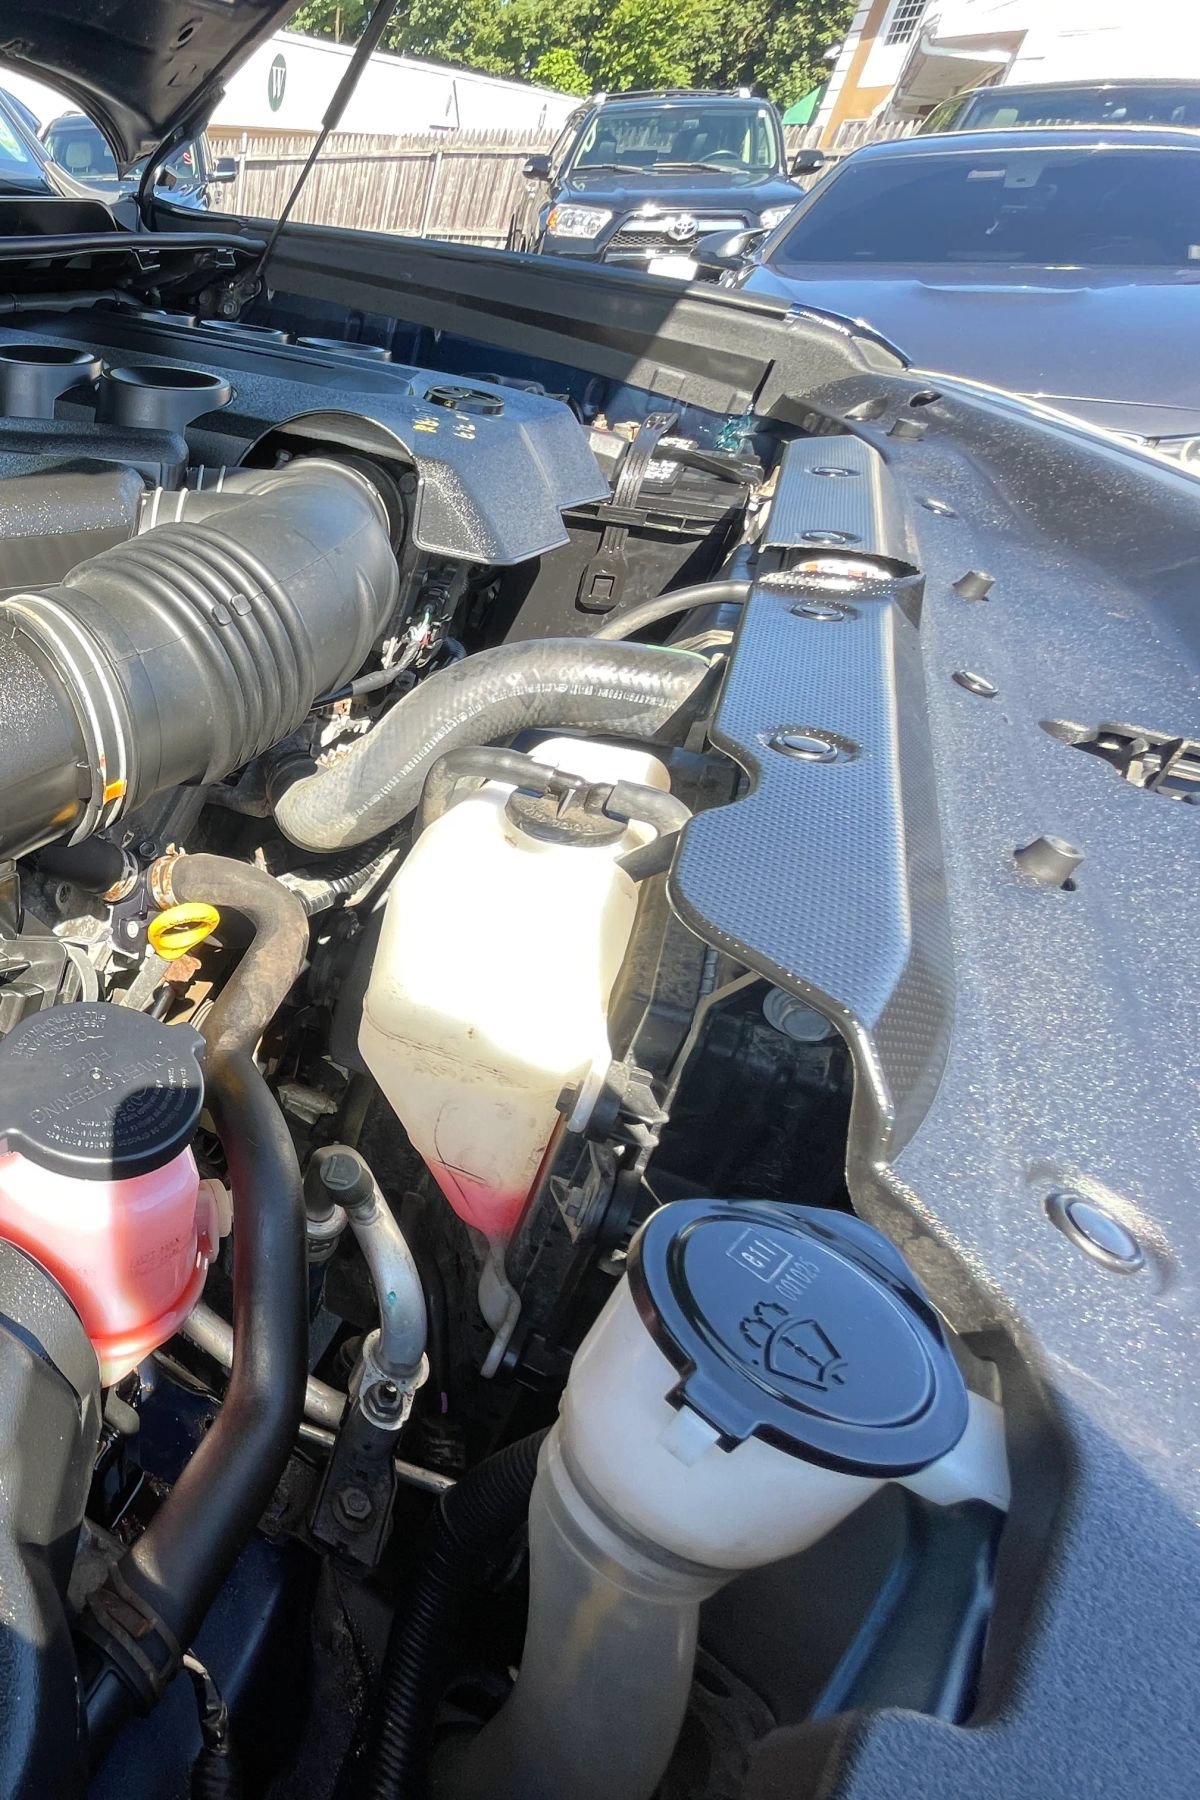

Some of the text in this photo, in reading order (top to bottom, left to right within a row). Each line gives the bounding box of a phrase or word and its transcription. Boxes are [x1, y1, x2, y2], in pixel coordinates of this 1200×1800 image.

[115, 1050, 179, 1084] POWER
[30, 1076, 114, 1124] STEERING
[741, 1239, 777, 1268] e11
